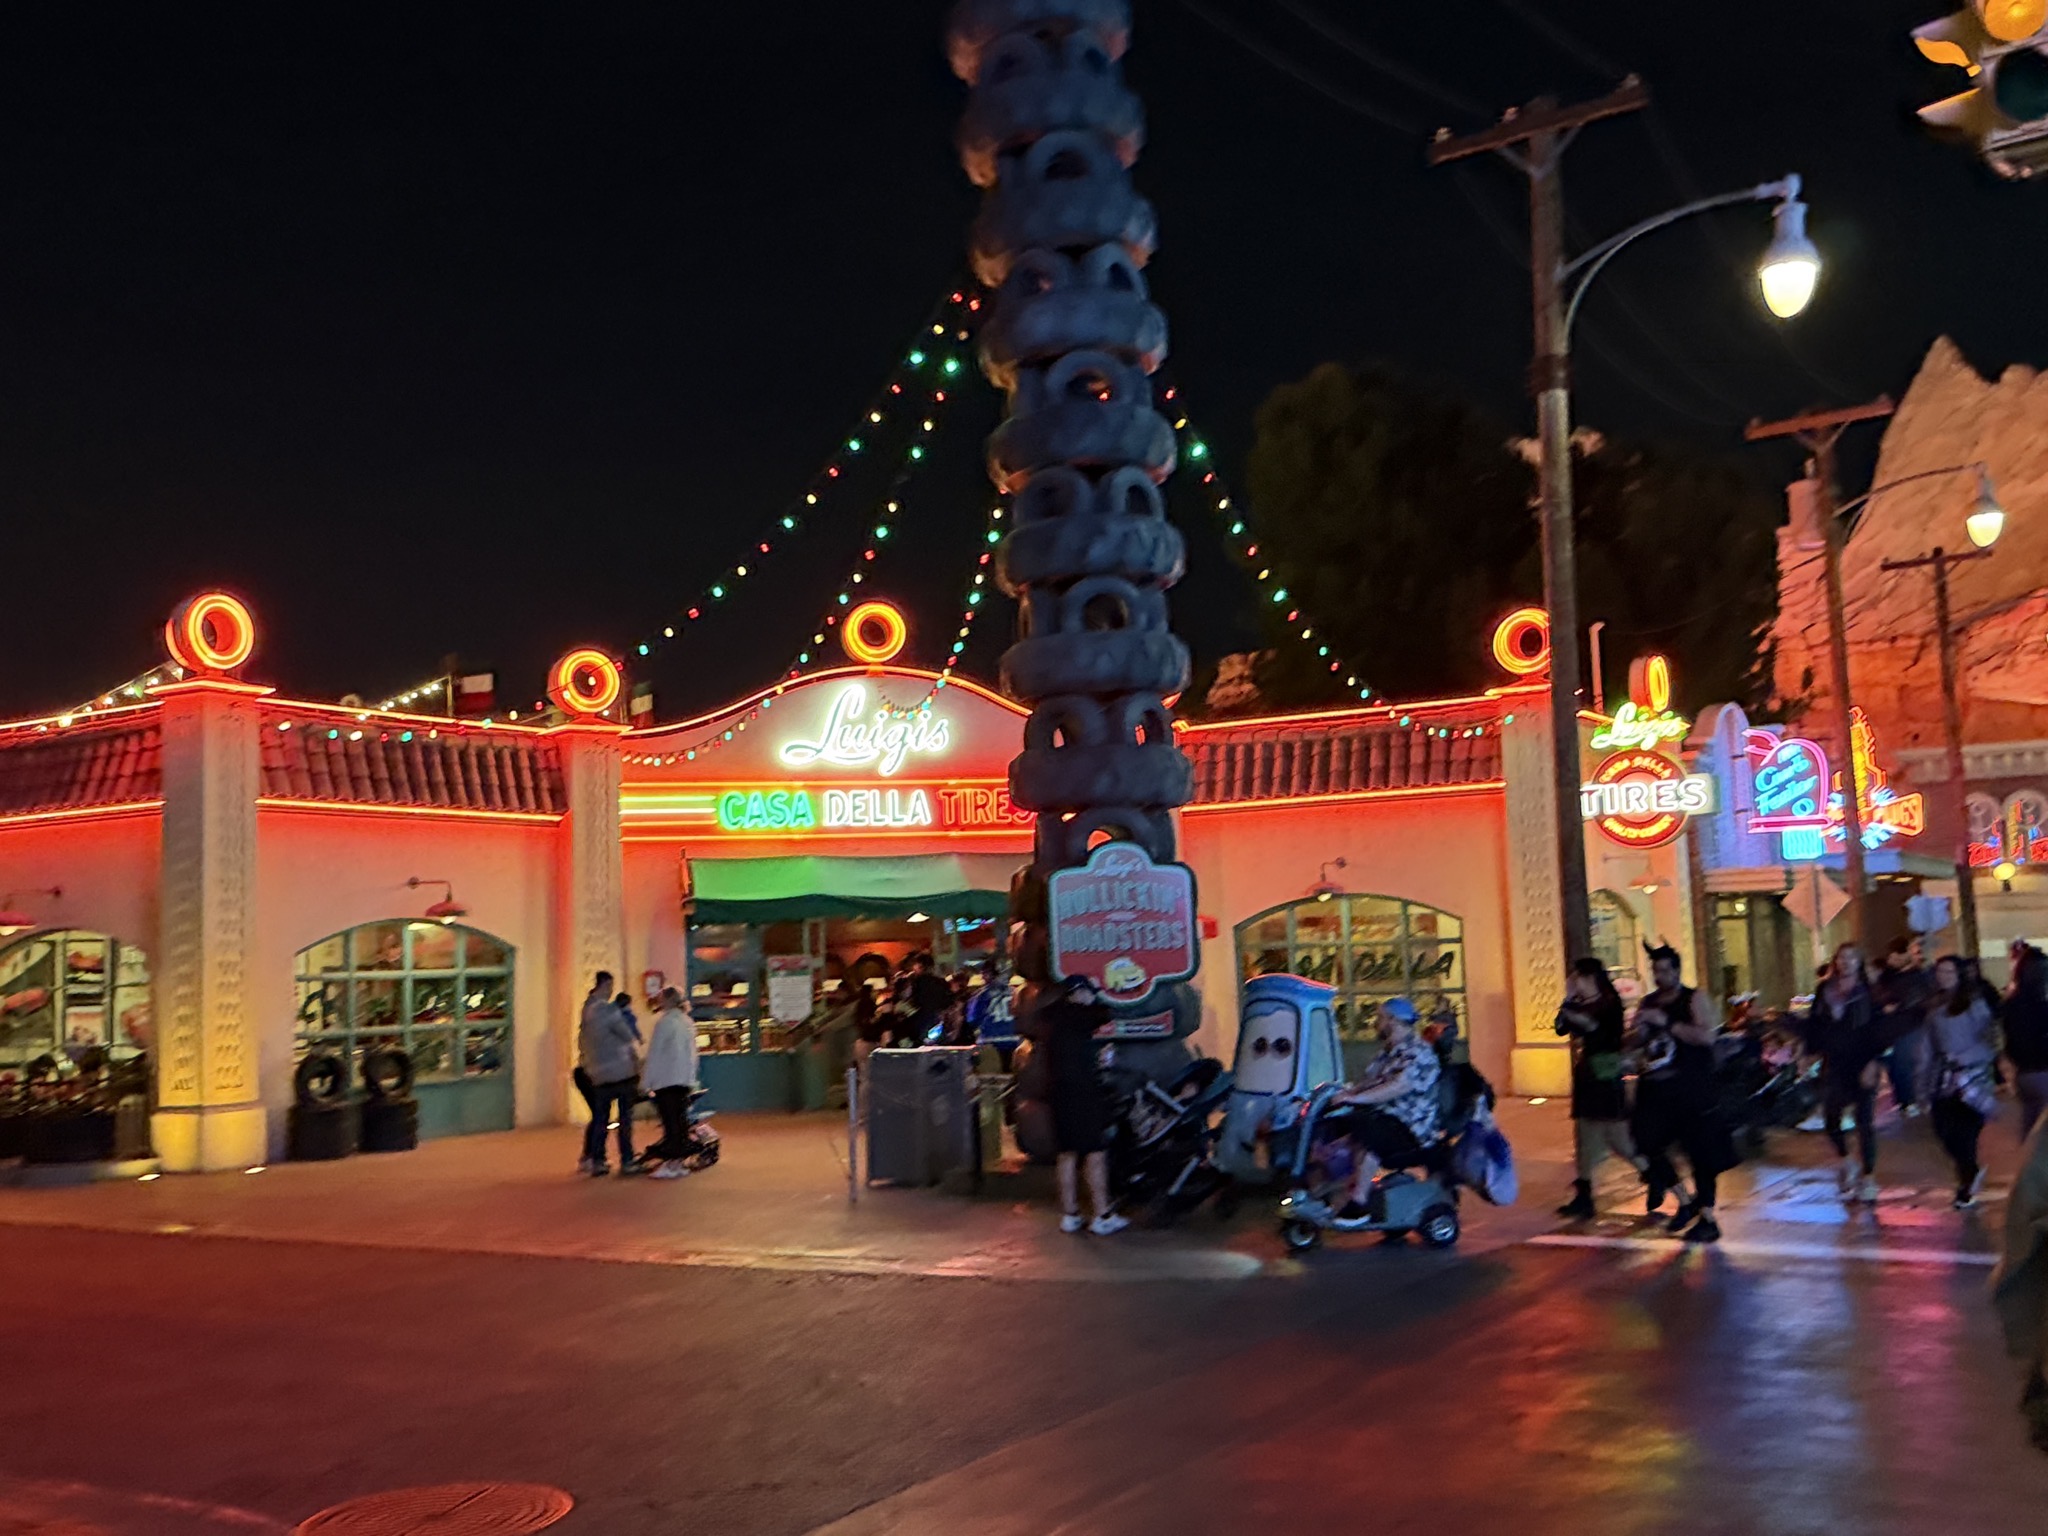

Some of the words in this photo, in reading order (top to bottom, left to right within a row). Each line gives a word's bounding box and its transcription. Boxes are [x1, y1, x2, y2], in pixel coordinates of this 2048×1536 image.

[719, 789, 816, 830] CASA
[822, 788, 933, 827] DELLA
[1580, 777, 1708, 818] TIRES
